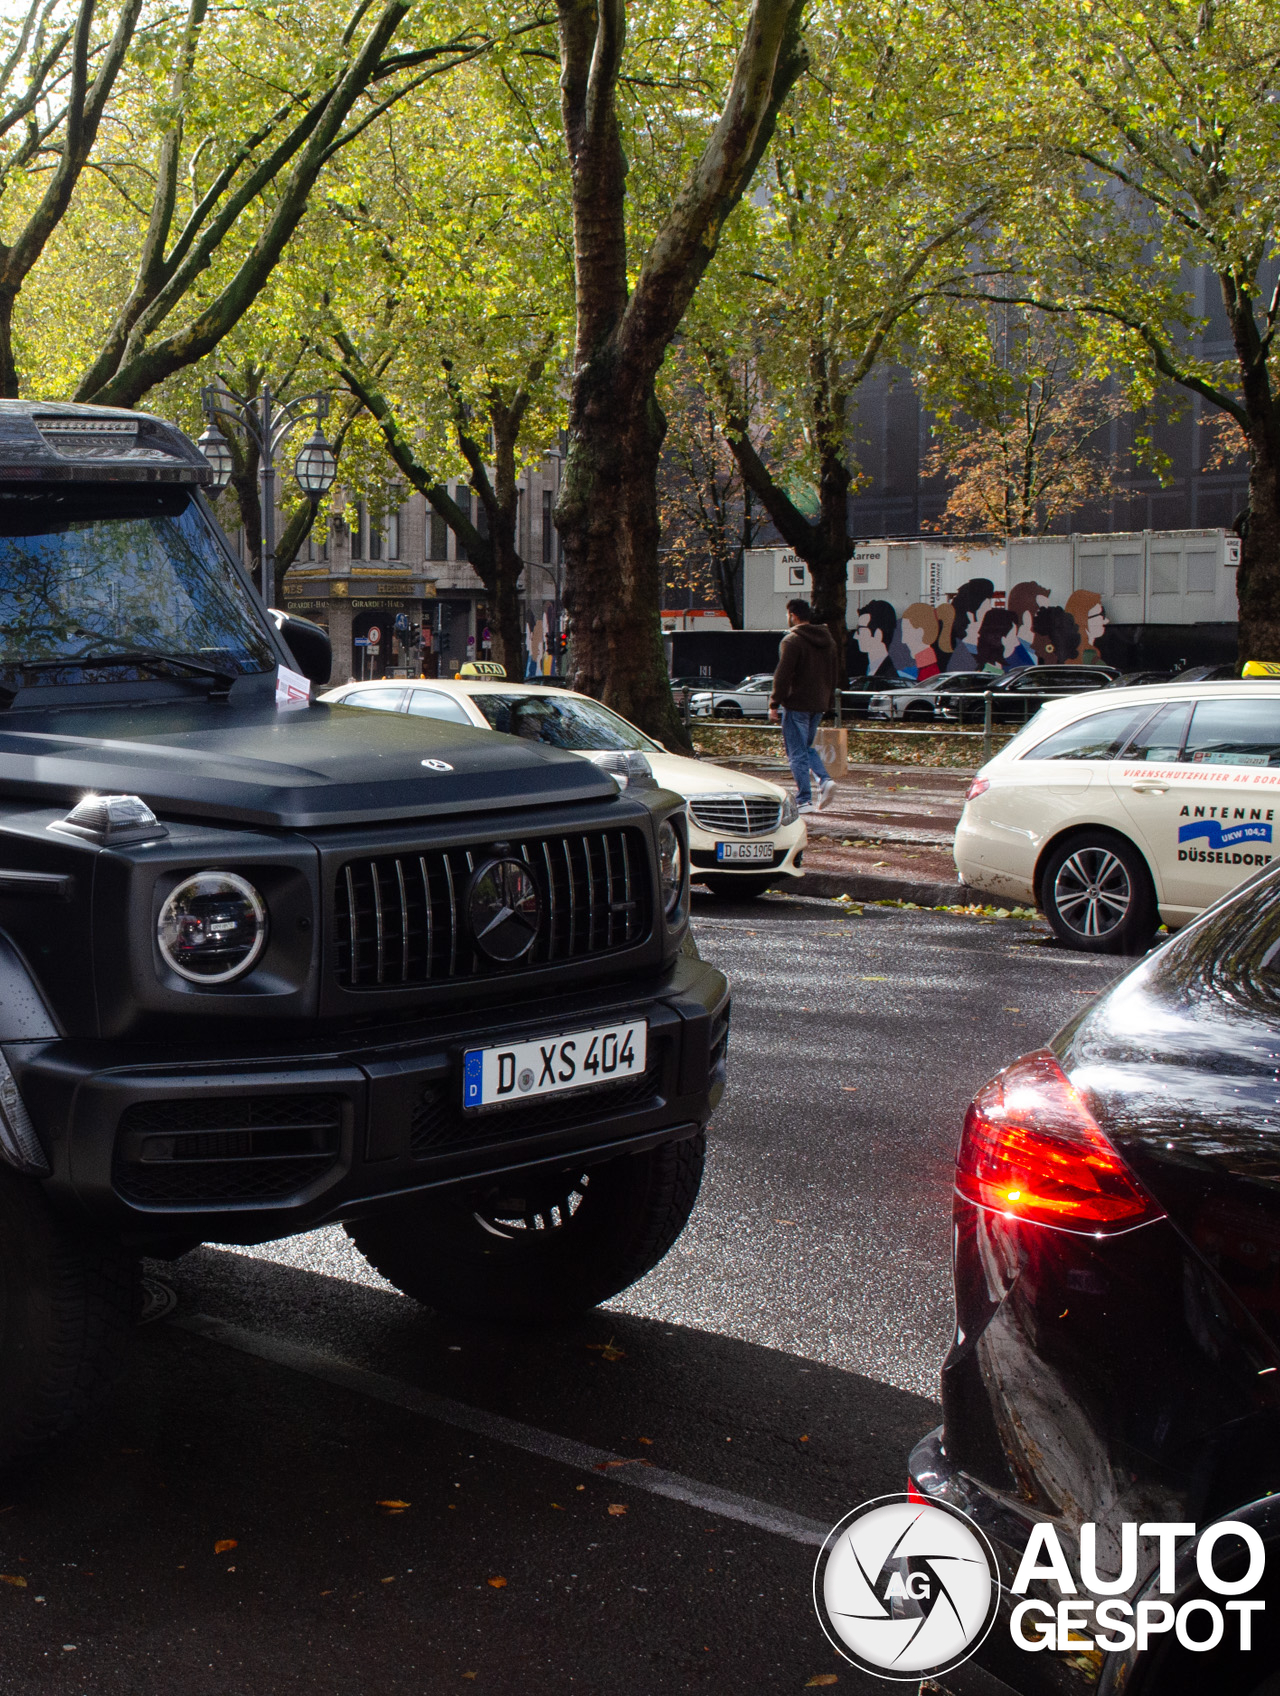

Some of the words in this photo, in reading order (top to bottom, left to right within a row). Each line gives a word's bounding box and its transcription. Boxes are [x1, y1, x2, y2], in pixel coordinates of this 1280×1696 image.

[474, 663, 503, 674] TAXI
[1123, 769, 1230, 782] VIRENSCHUTZFILTER
[1233, 774, 1250, 783] AN
[1179, 805, 1275, 821] ANTENNE
[1221, 829, 1244, 843] UKW
[1244, 828, 1267, 837] 104,2
[725, 845, 732, 857] D
[739, 845, 752, 857] GS
[470, 1084, 478, 1097] D
[496, 1052, 516, 1095] D
[538, 1040, 576, 1087] XS
[583, 1029, 635, 1076] 404
